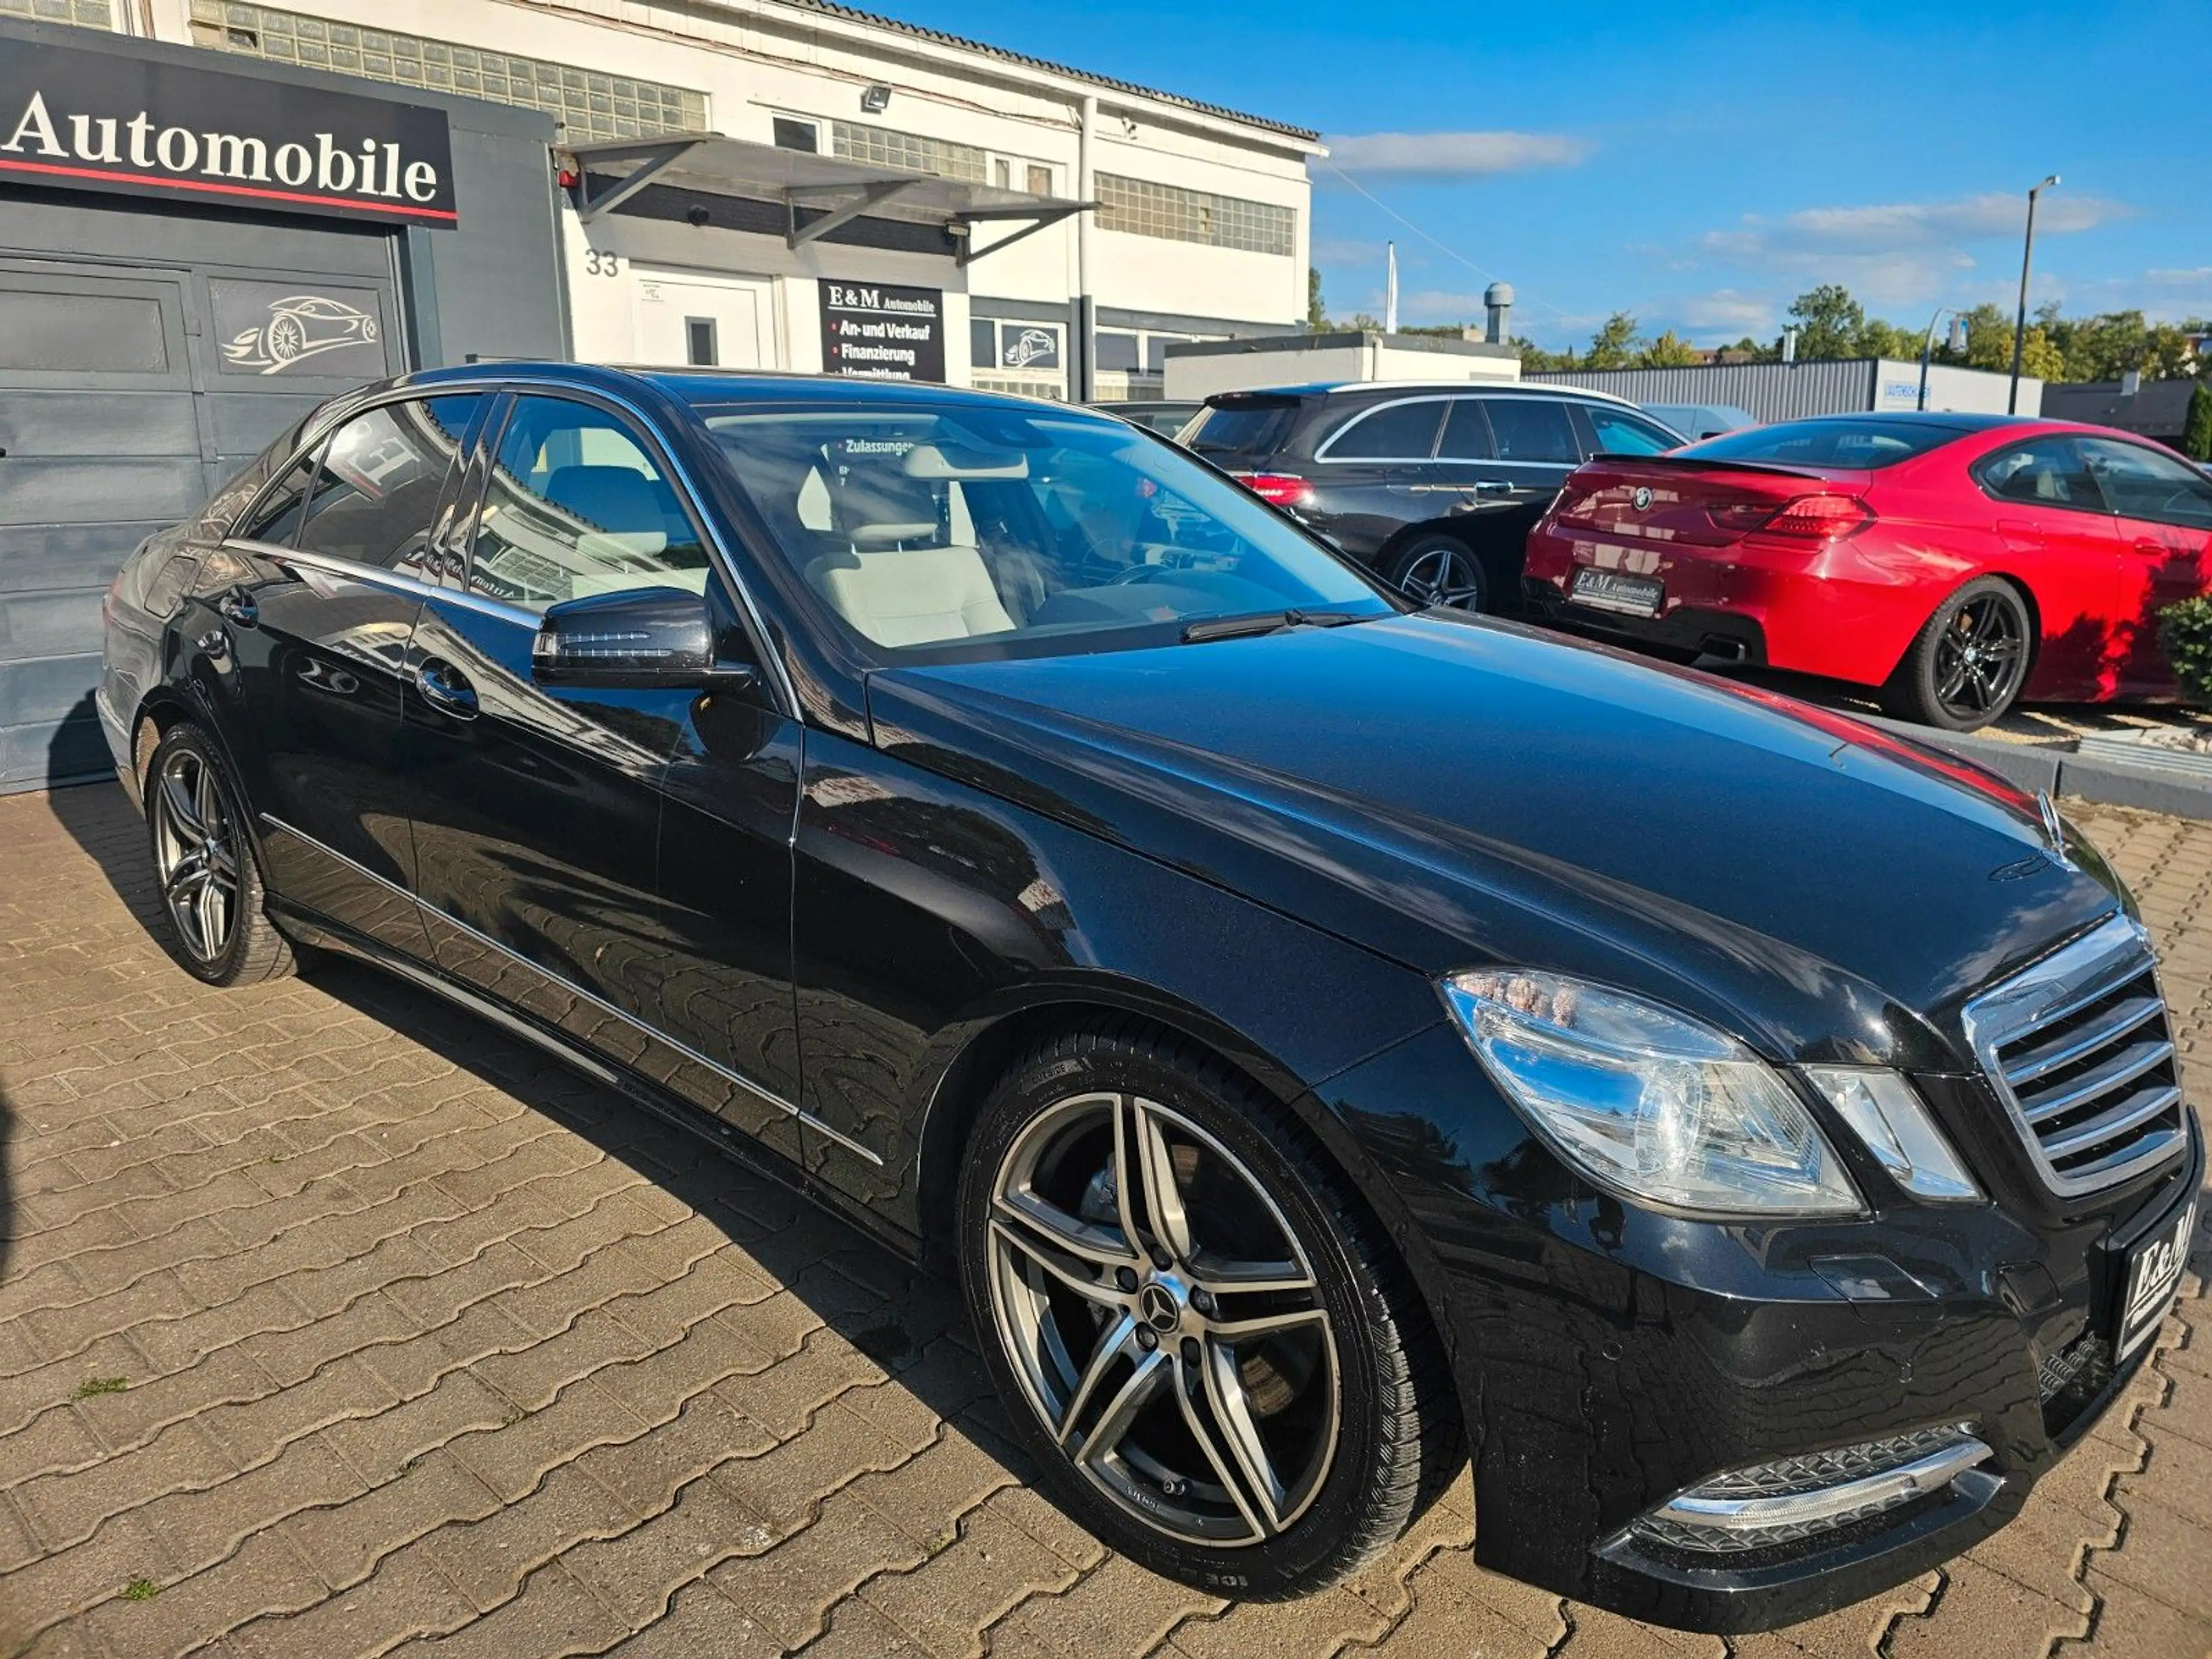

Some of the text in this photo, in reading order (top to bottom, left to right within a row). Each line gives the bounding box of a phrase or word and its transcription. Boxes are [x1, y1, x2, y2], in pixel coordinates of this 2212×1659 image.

[1, 90, 437, 202] Automobile
[585, 248, 618, 277] 33
[884, 298, 934, 312] Automobile
[839, 320, 930, 340] An- und Verkauf
[841, 344, 915, 366] Finanzierung
[1577, 571, 1613, 590] E&M
[1611, 582, 1658, 599] Automobile
